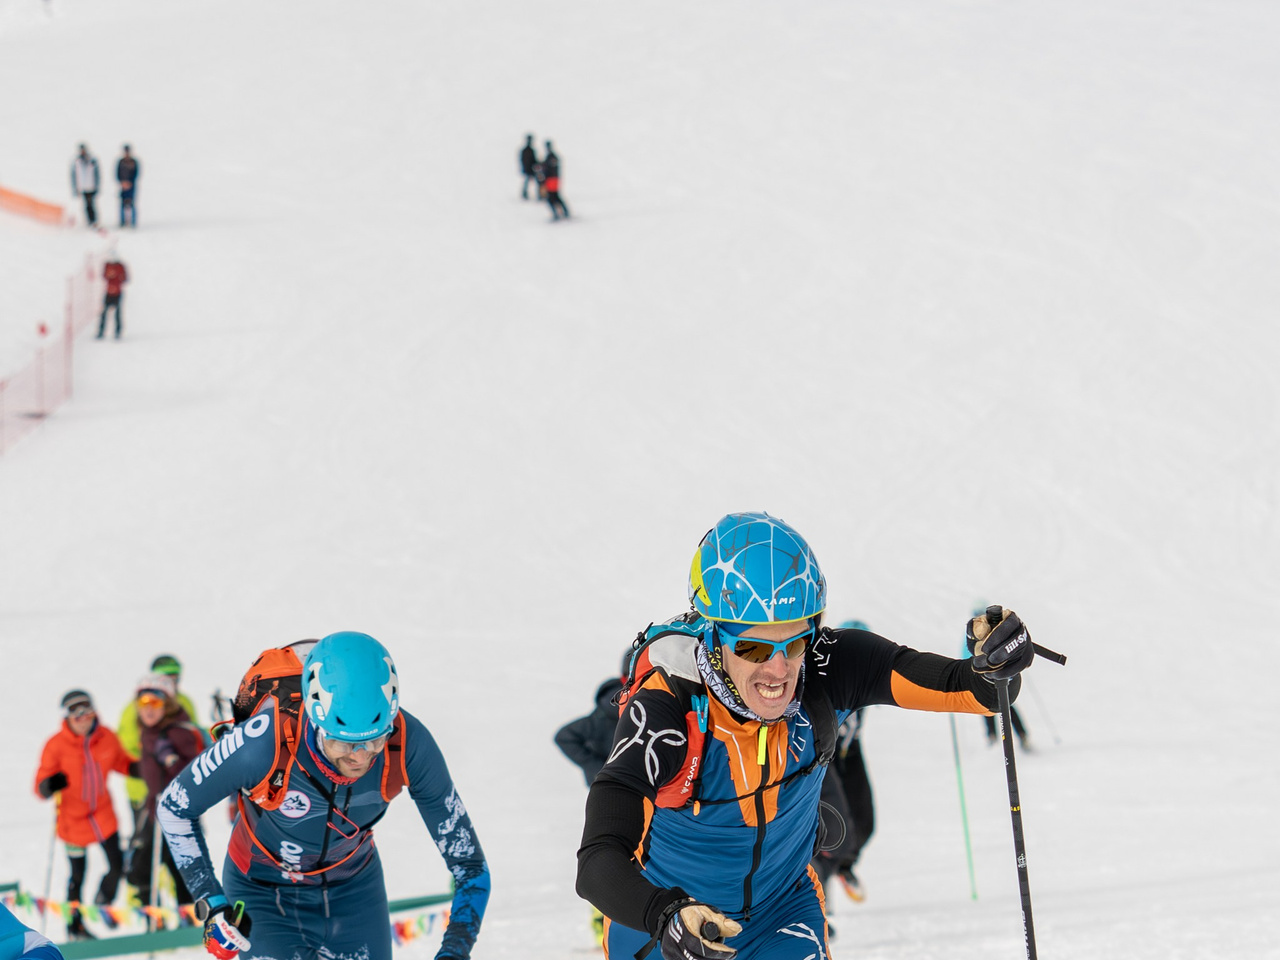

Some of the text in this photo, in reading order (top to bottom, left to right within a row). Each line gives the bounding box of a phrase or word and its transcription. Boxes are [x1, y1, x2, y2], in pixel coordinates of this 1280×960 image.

[762, 597, 796, 606] CAMP
[191, 714, 270, 786] SKIMO
[685, 756, 699, 787] CAMP
